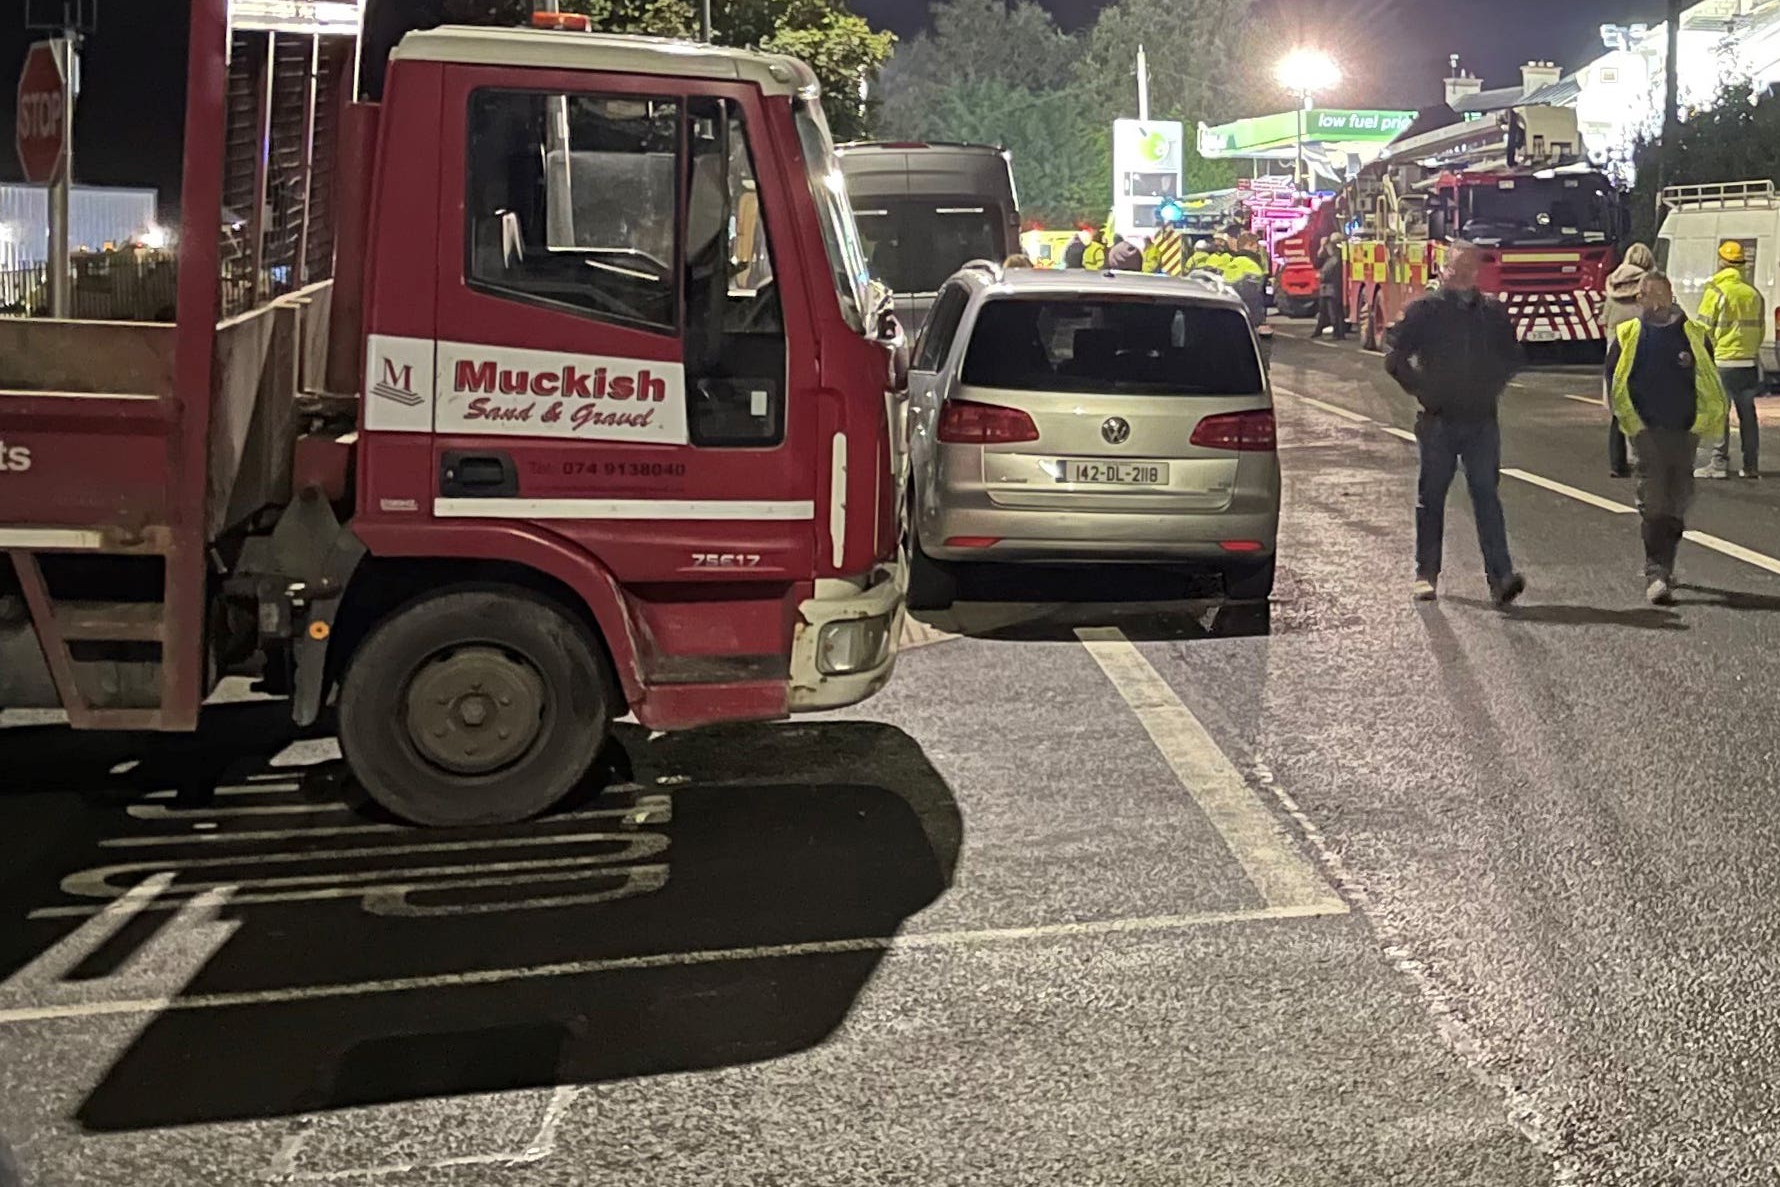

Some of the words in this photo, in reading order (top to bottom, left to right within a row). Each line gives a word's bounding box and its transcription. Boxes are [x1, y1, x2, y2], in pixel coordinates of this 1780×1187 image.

[20, 91, 62, 139] STOP
[1318, 113, 1346, 129] low
[1349, 113, 1379, 130] fuel
[381, 356, 414, 393] M
[453, 359, 667, 403] Muckish
[463, 397, 538, 423] Sand
[540, 400, 564, 425] &
[569, 402, 656, 431] Gravel
[563, 462, 598, 476] 074
[604, 462, 686, 477] 9138040
[1075, 465, 1158, 482] 142-DL-2118
